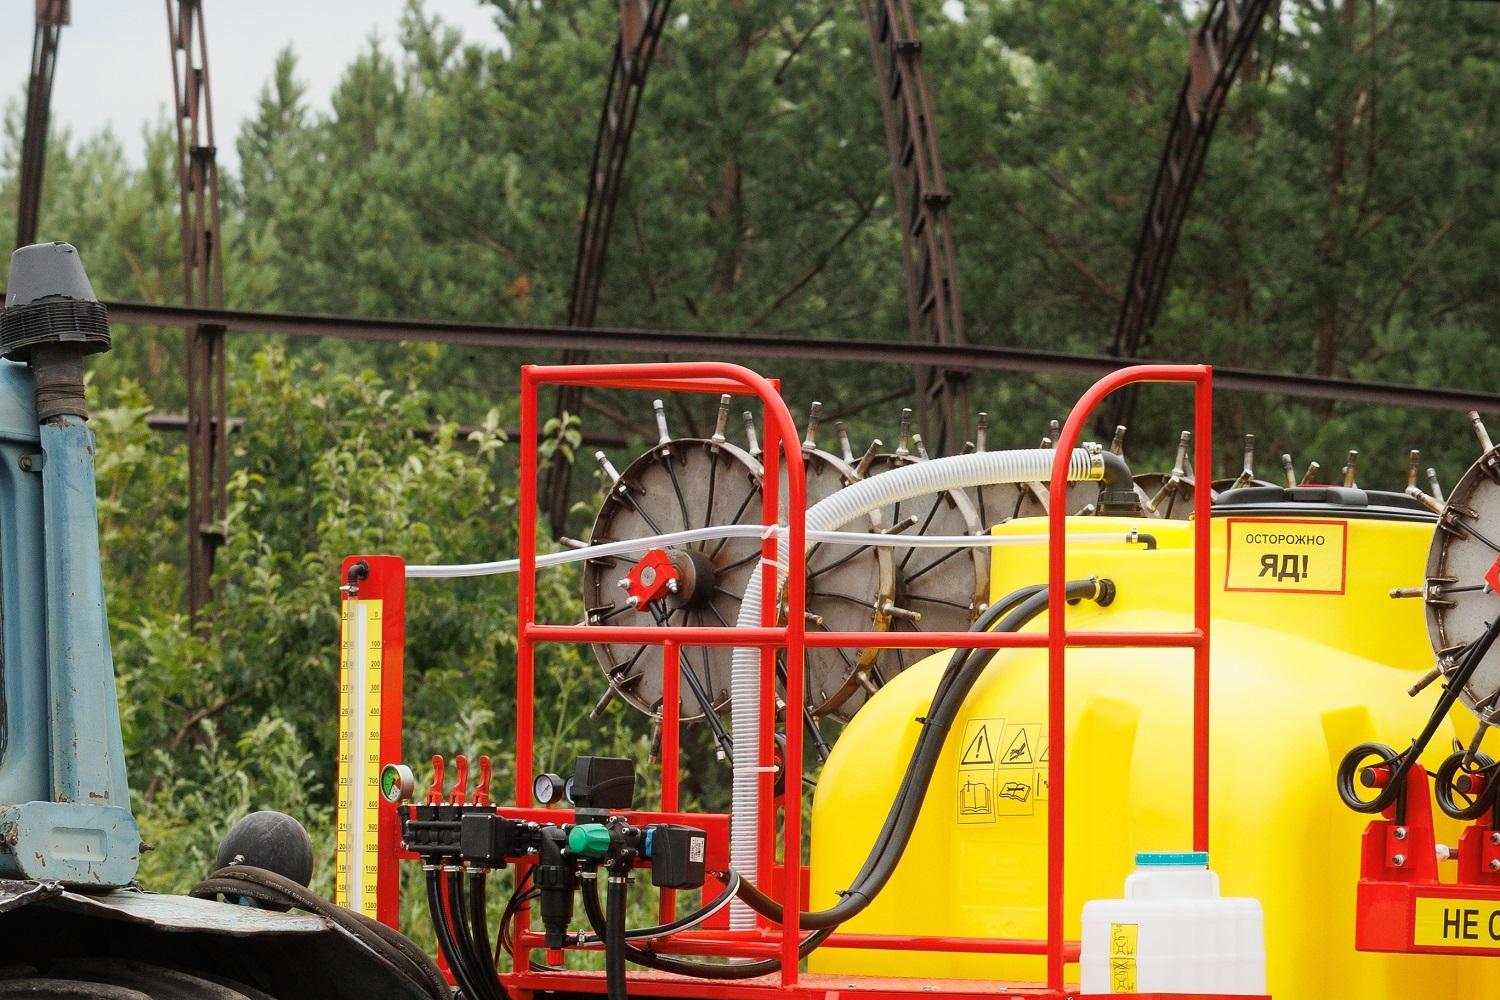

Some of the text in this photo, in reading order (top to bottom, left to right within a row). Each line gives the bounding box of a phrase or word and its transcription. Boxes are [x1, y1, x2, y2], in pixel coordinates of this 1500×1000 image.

[1245, 533, 1325, 546] ОСТОРОЖНО
[1258, 553, 1309, 583] ЯД!
[371, 640, 381, 648] 100
[371, 660, 380, 668] 200
[368, 800, 378, 808] 800
[368, 823, 378, 831] 900
[366, 843, 378, 851] 1000
[1442, 908, 1480, 940] НЕ
